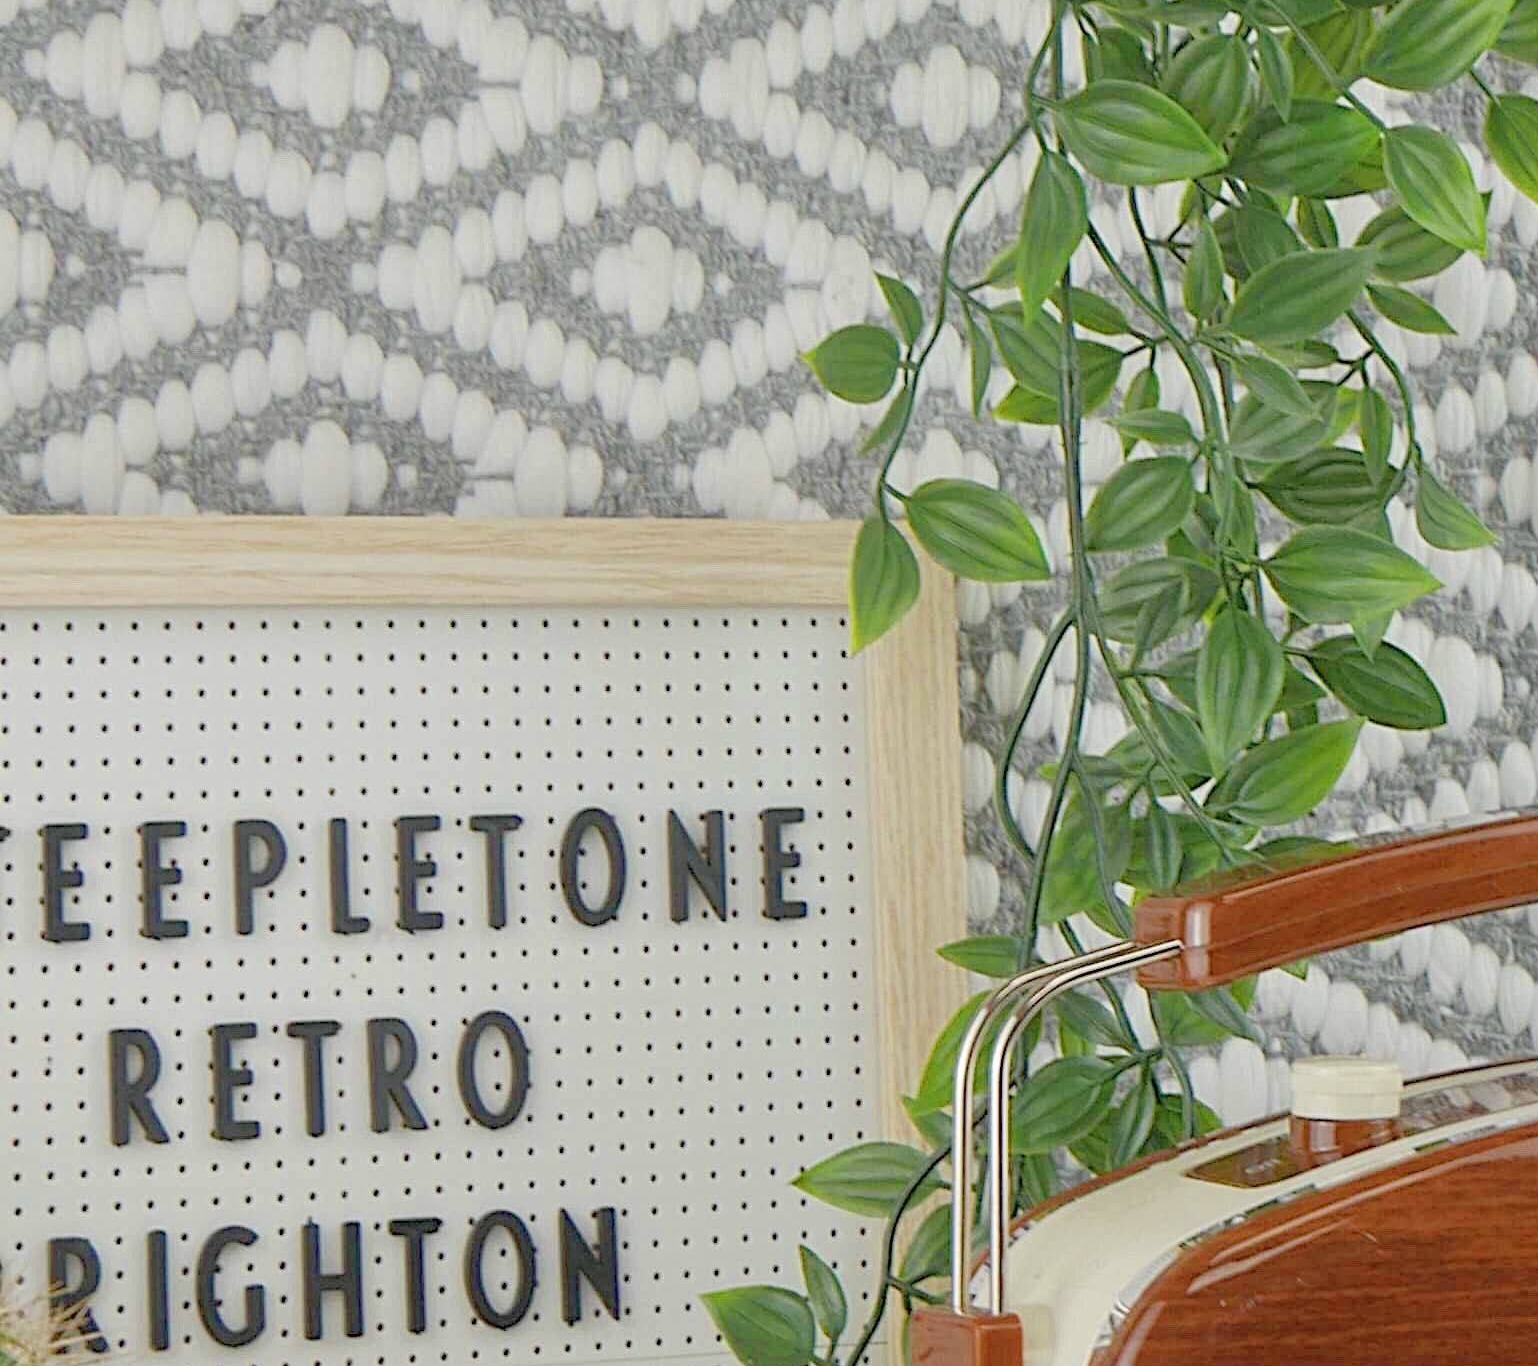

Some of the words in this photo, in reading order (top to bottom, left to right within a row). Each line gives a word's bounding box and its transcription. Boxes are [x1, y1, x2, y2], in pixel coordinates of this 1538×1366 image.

[0, 806, 808, 943] EEPLETONE
[108, 1010, 532, 1146] RETRO
[0, 1206, 622, 1354] RIGHTON
